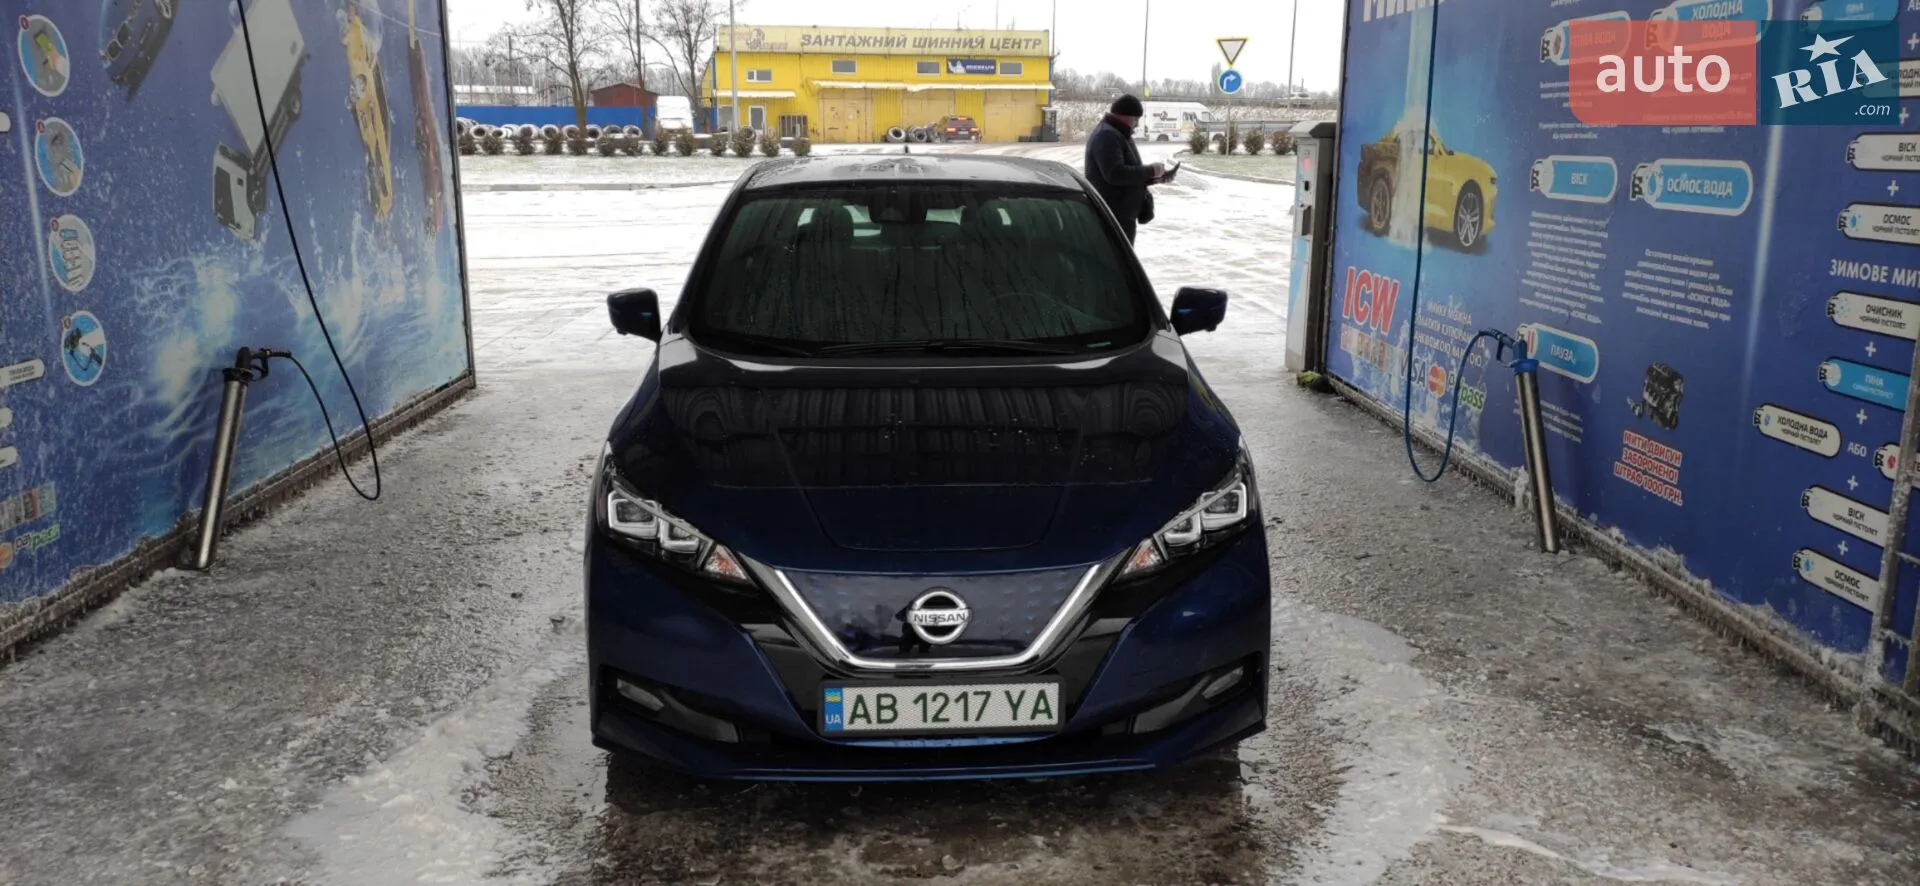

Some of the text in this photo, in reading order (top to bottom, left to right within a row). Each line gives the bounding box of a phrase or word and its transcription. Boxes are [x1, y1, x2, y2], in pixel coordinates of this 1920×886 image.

[989, 37, 1042, 52] ЦЕНТР
[1667, 176, 1733, 198] ОСМОС ВОДА
[1883, 213, 1912, 226] ОСМОС
[1829, 259, 1889, 283] ЗИМОВЕ
[1342, 266, 1400, 335] ICW
[1865, 304, 1904, 320] ОЧИСНИК
[1400, 350, 1426, 388] VSA
[1777, 415, 1829, 439] ХОЛОДНА ВОДА
[1648, 441, 1682, 466] ДВИГУН
[1847, 441, 1867, 457] АБО
[1622, 448, 1679, 484] ЗАБОРОНЕНО!
[1614, 462, 1643, 487] ШТРАФ
[1643, 475, 1664, 497] 1000
[1834, 570, 1860, 589] ОСМОС
[913, 613, 966, 623] NISSAN
[848, 689, 1053, 725] AB 1217 YA
[826, 713, 842, 725] UA
